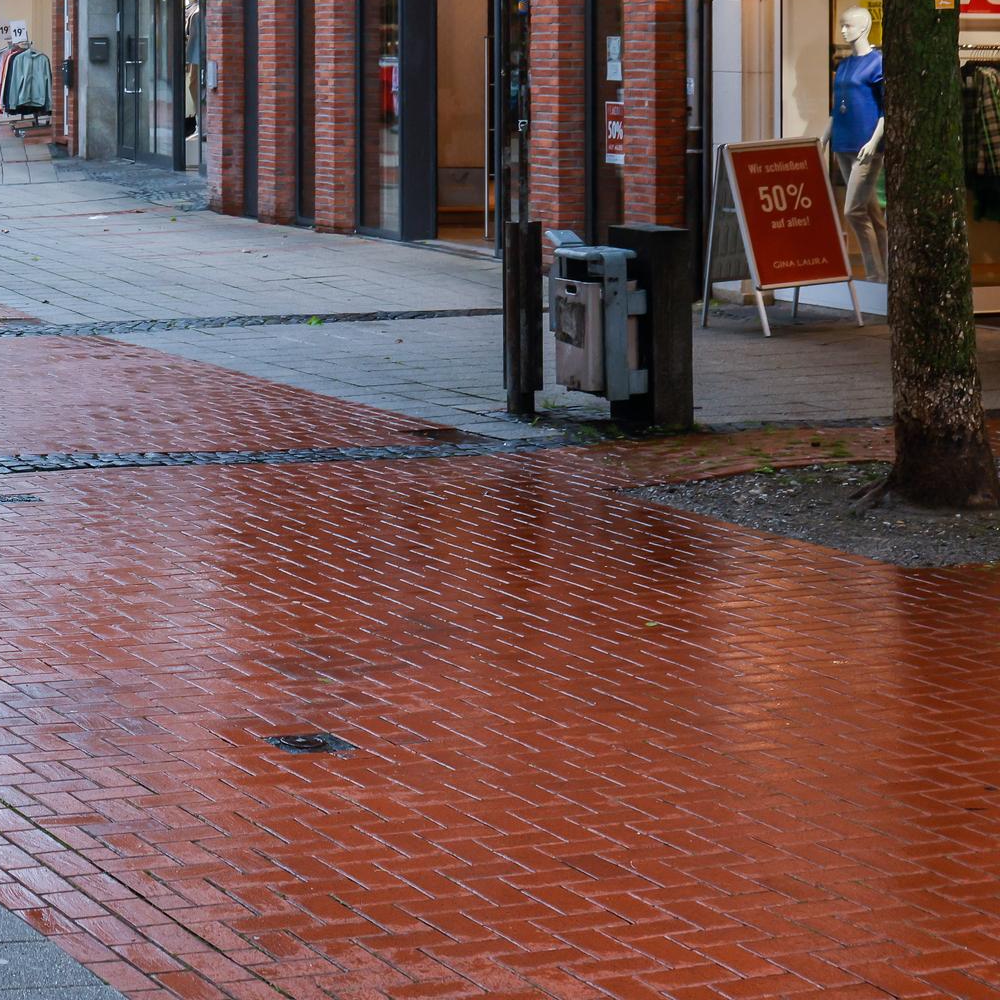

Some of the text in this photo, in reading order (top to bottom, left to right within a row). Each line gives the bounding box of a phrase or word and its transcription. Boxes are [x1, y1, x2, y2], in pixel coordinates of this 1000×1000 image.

[748, 160, 808, 174] Wir schließen!
[758, 182, 813, 213] 50%
[771, 216, 811, 229] auf alles!
[773, 257, 829, 269] GINA LAURA
